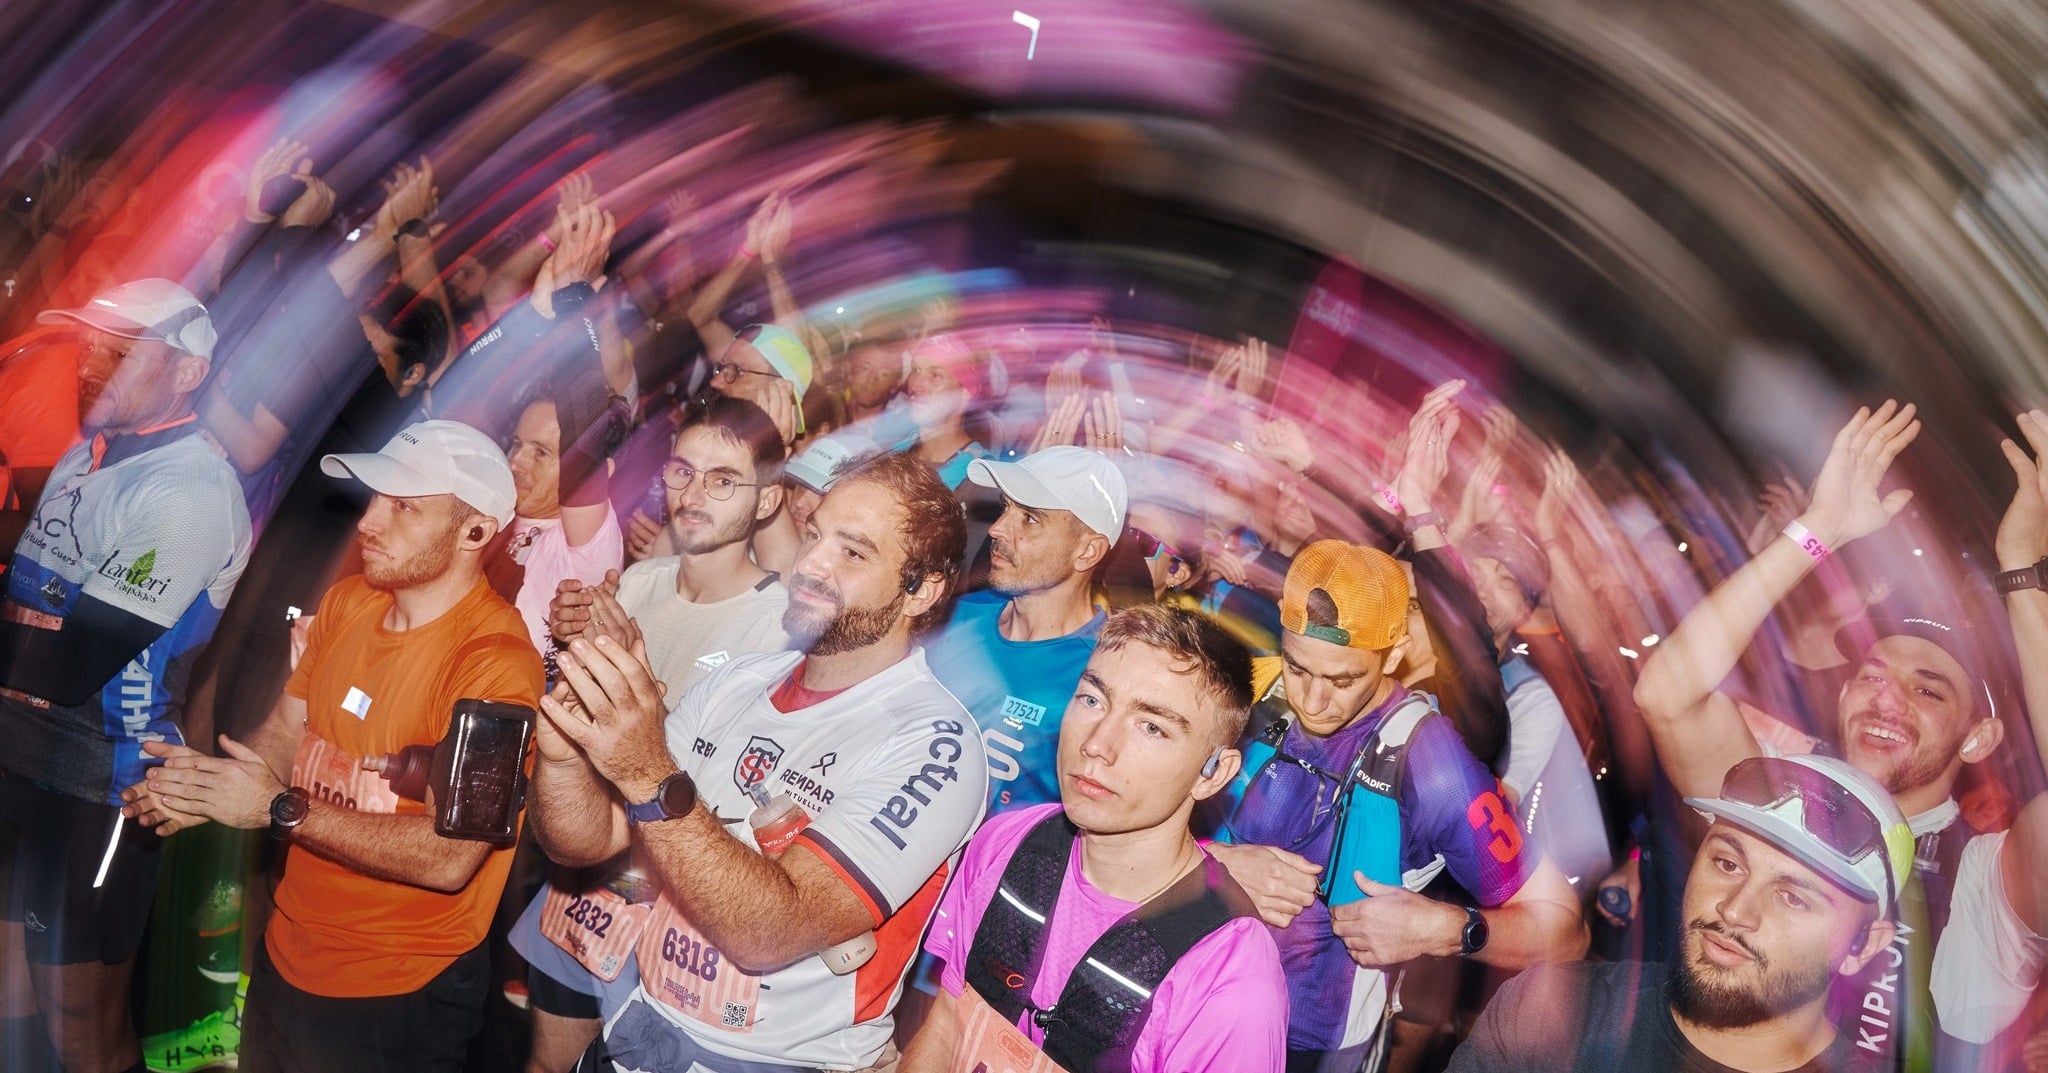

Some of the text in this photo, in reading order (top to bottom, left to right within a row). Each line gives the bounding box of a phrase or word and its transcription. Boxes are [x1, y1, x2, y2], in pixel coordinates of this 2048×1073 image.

[470, 325, 504, 356] KIPRUN
[98, 549, 172, 597] Lanteri
[1903, 617, 1952, 632] KIPRUN
[1005, 699, 1041, 723] 27521
[869, 719, 964, 852] actual
[1356, 769, 1392, 793] EVADICT
[564, 892, 613, 940] 2832
[662, 927, 720, 982] 6318
